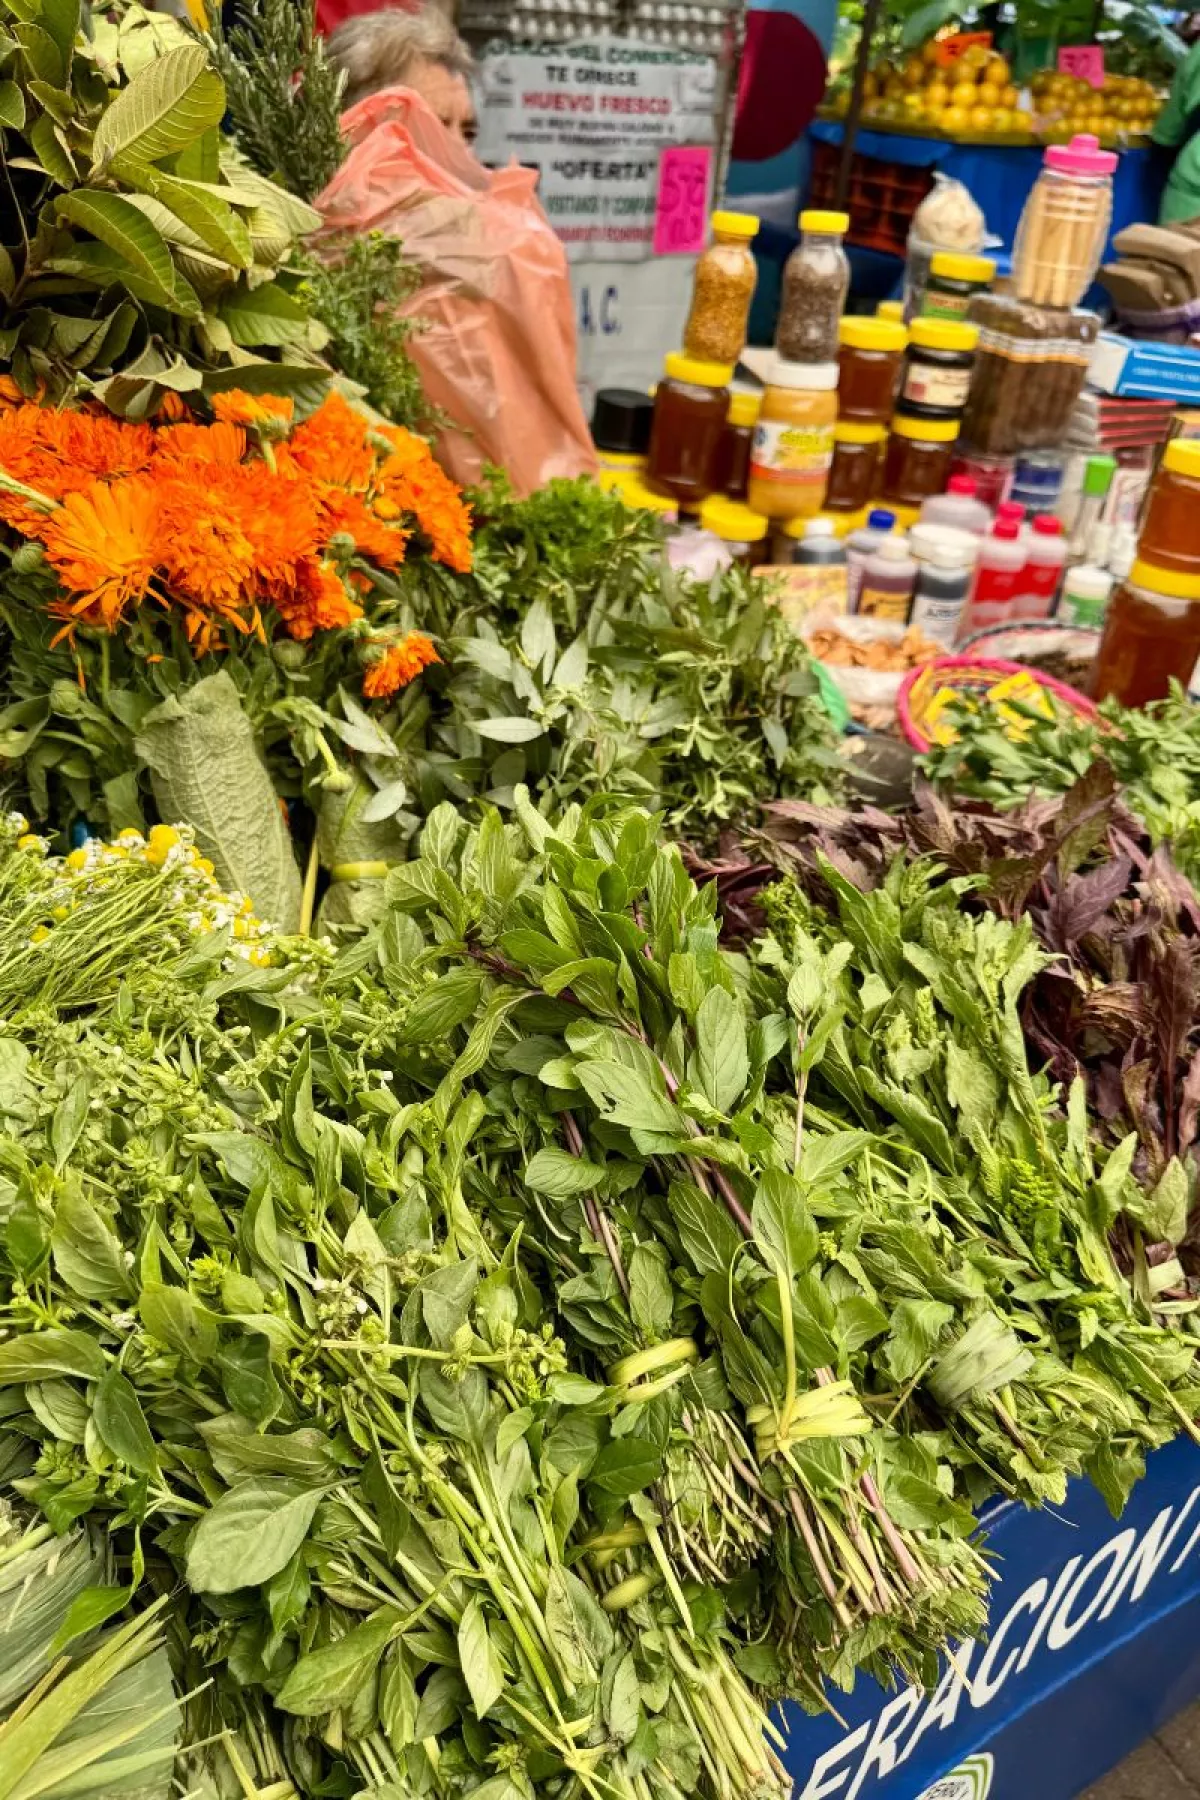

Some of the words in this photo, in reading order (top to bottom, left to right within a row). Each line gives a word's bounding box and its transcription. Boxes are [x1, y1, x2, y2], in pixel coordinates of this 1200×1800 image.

[546, 66, 568, 84] TE
[575, 68, 639, 86] OFRECE
[521, 92, 595, 113] HUEVO
[600, 95, 672, 115] FRESCO
